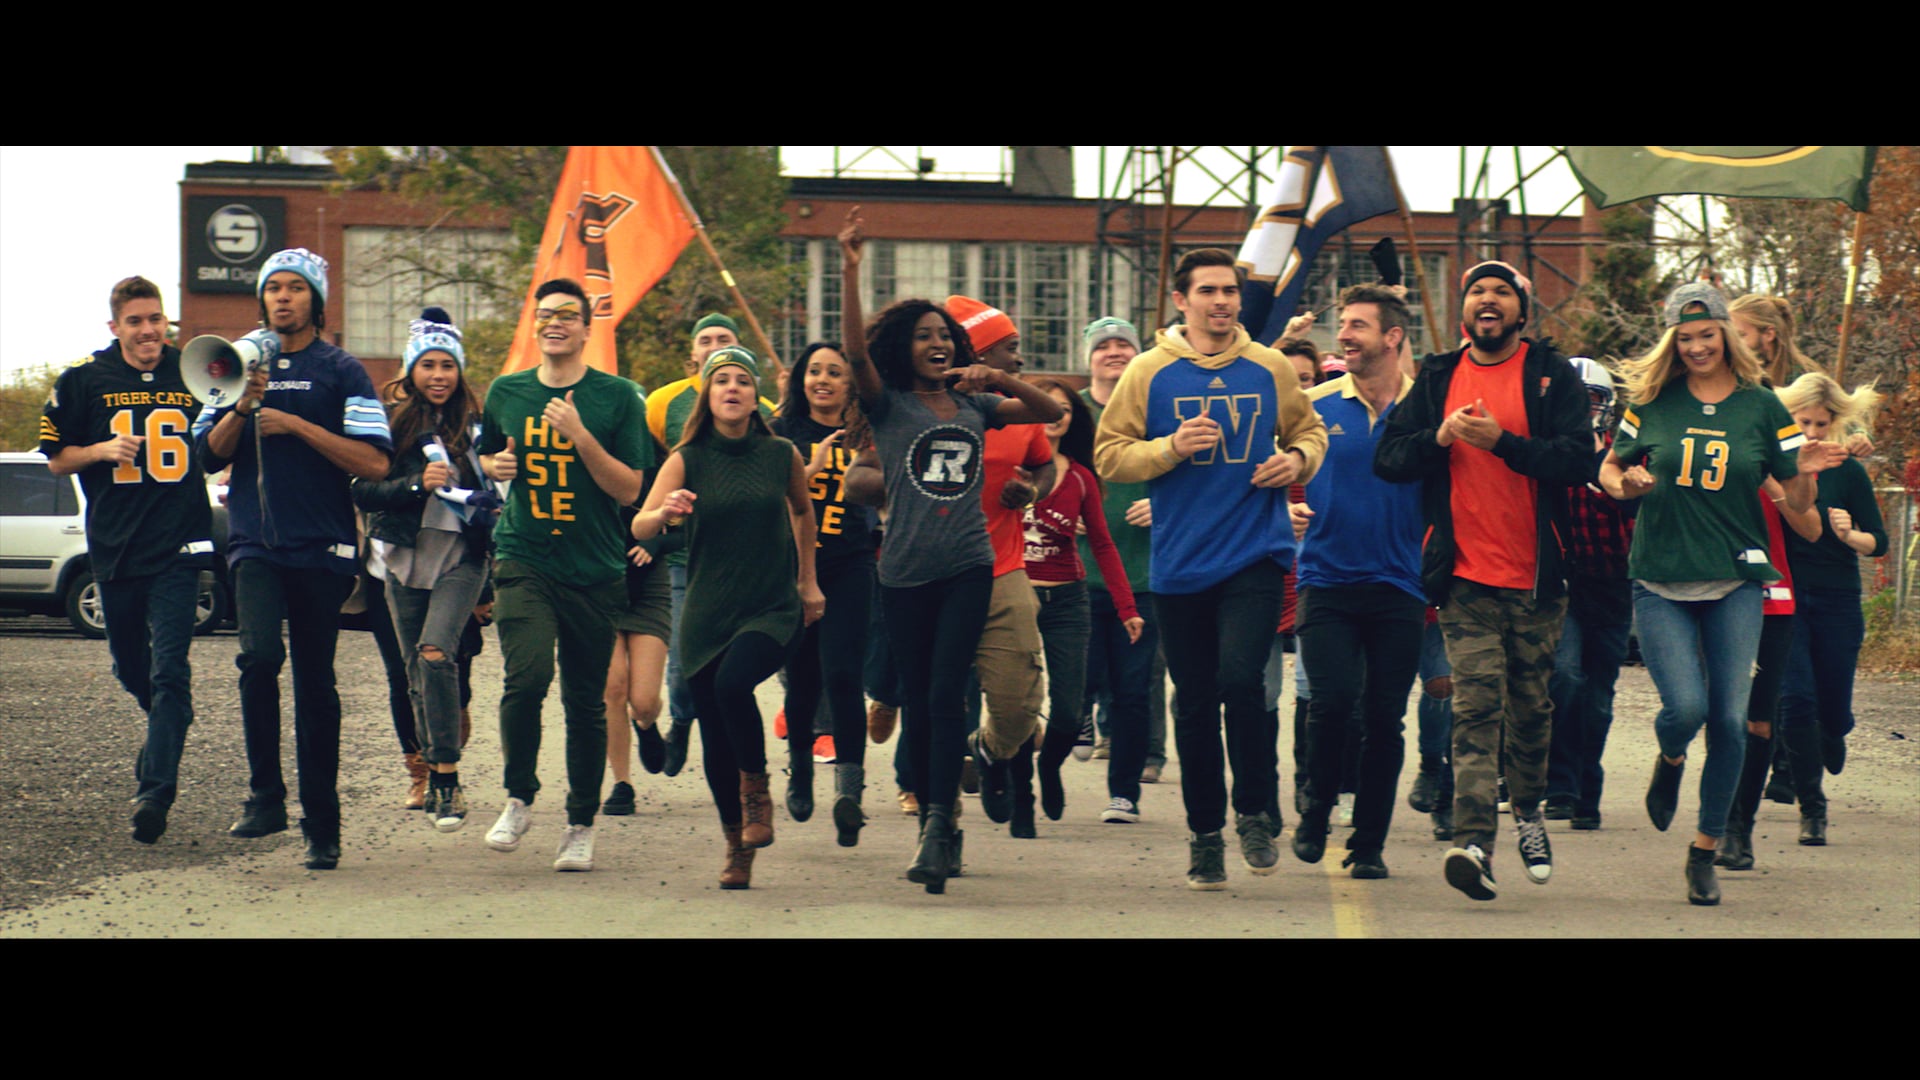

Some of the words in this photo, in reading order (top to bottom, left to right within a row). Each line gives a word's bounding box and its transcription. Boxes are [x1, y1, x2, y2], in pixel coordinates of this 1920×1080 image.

[198, 266, 229, 281] SIM
[102, 391, 194, 408] TIGER-CATS
[109, 408, 190, 484] 16
[922, 440, 973, 483] R
[525, 452, 575, 488] ST
[1675, 437, 1730, 491] 13
[528, 489, 576, 522] LE
[821, 505, 846, 535] E
